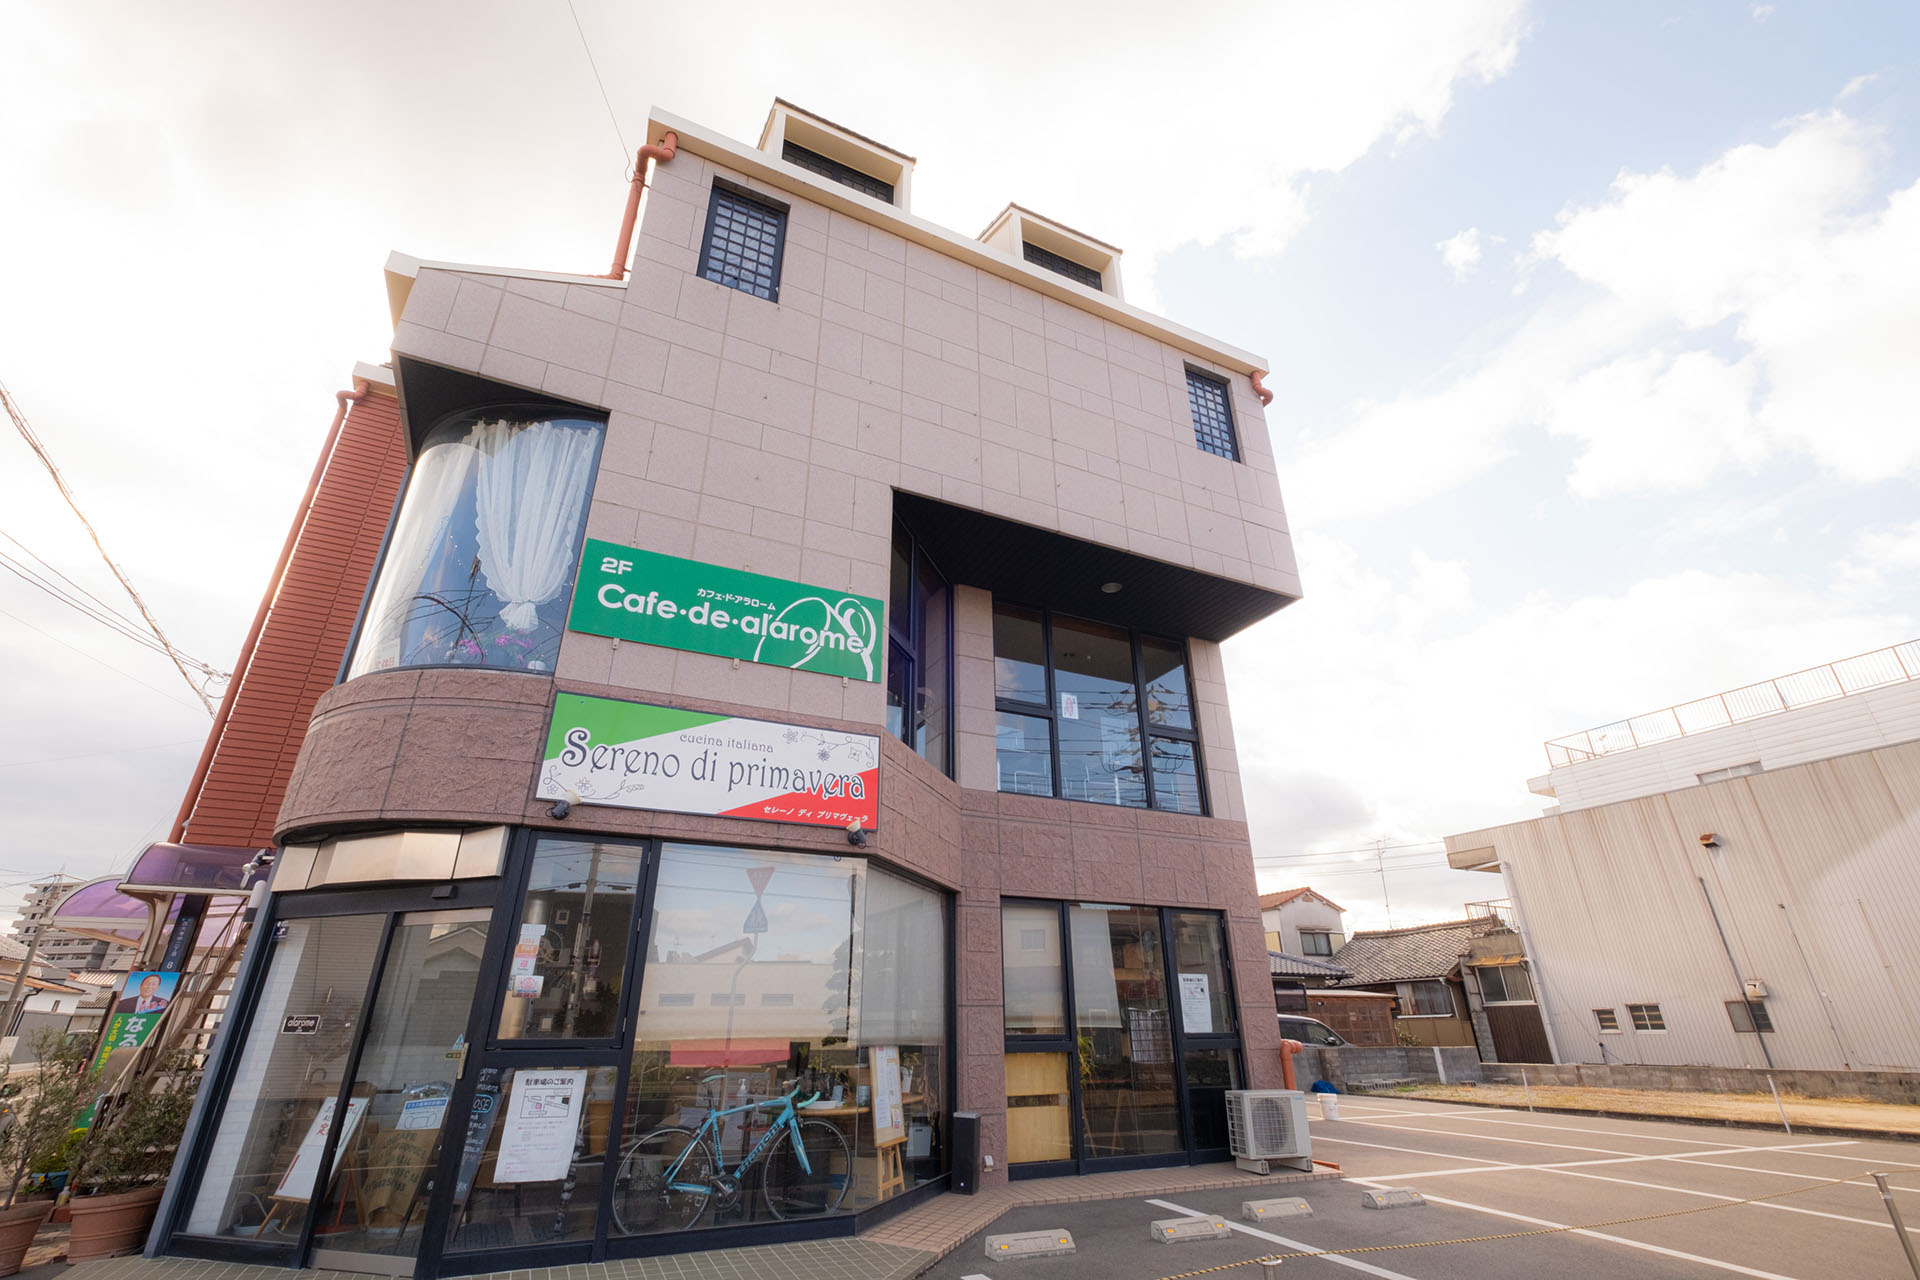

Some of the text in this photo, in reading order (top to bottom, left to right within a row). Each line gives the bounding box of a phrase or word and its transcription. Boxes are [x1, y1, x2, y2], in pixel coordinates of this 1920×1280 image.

[600, 557, 633, 575] 2F
[679, 733, 773, 753] cucina italiana
[561, 729, 865, 798] Sereno di primavera
[763, 805, 794, 815] セレーノ
[798, 808, 812, 817] ディ
[525, 1078, 574, 1086] 駐車場のご案内
